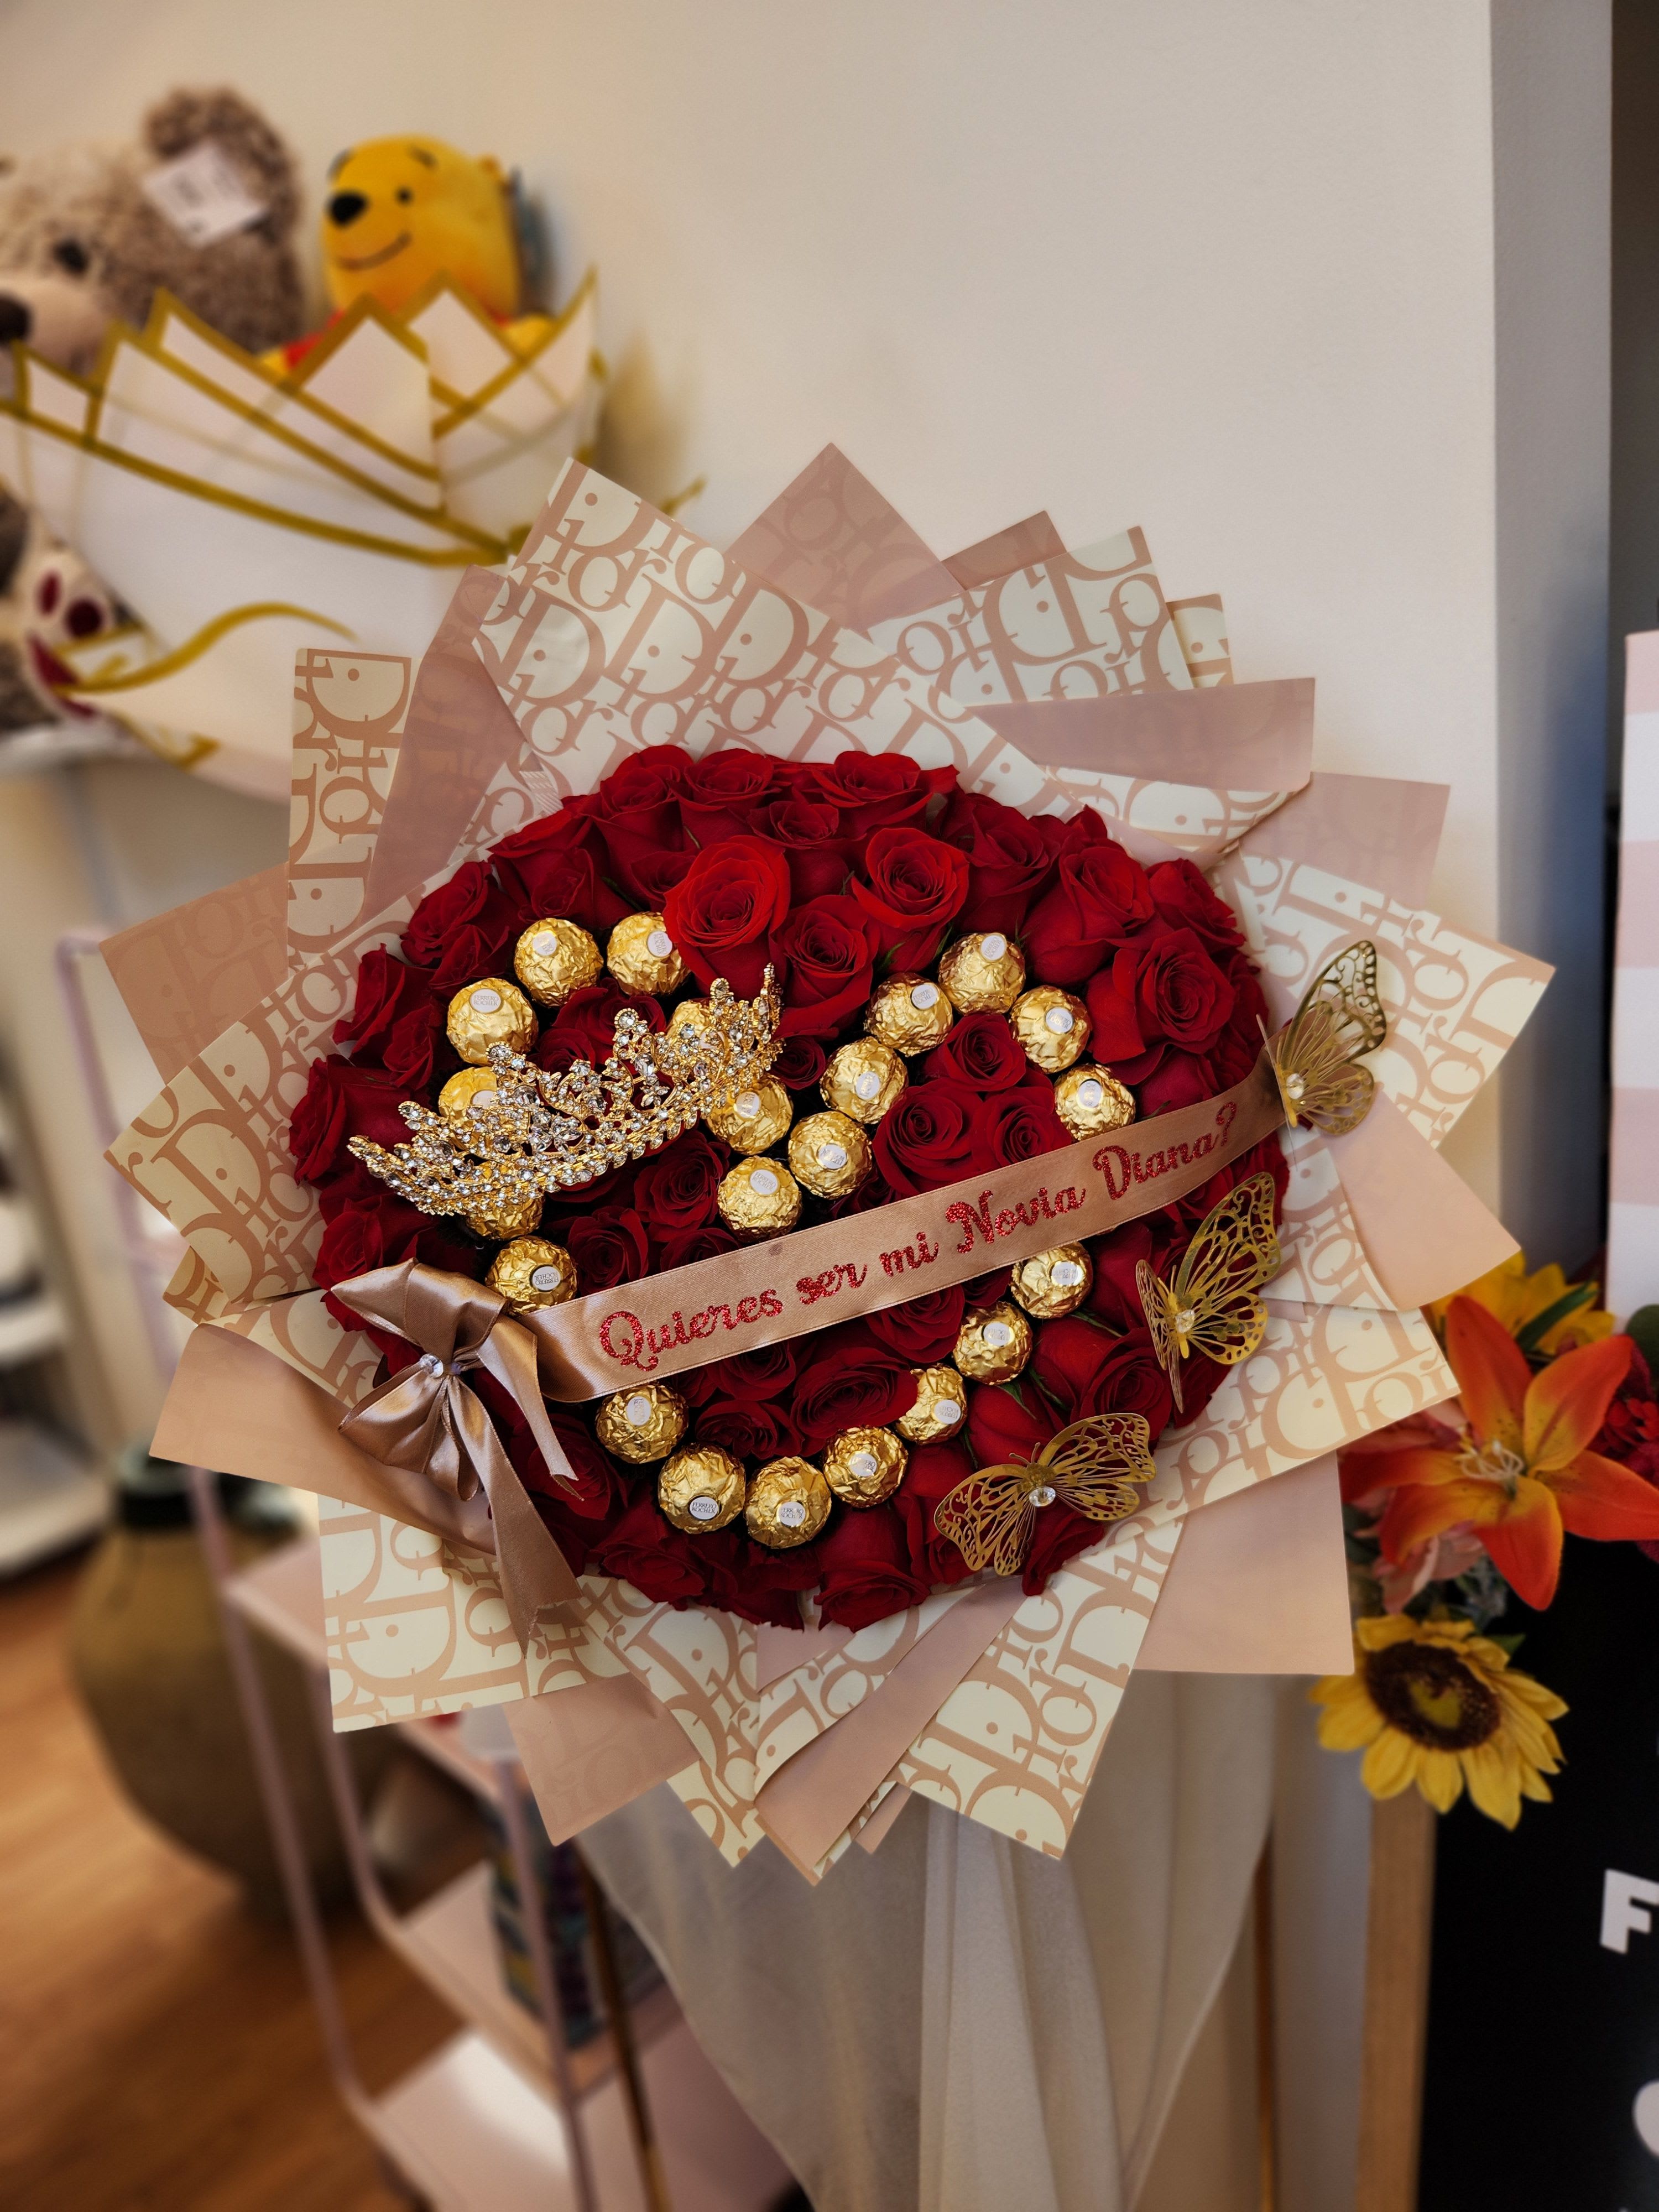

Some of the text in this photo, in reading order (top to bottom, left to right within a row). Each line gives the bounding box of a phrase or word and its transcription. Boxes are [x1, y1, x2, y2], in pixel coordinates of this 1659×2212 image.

[535, 1277, 559, 1286] FERRERO
[598, 1102, 1238, 1371] Quieres ser mi Novia Diana?
